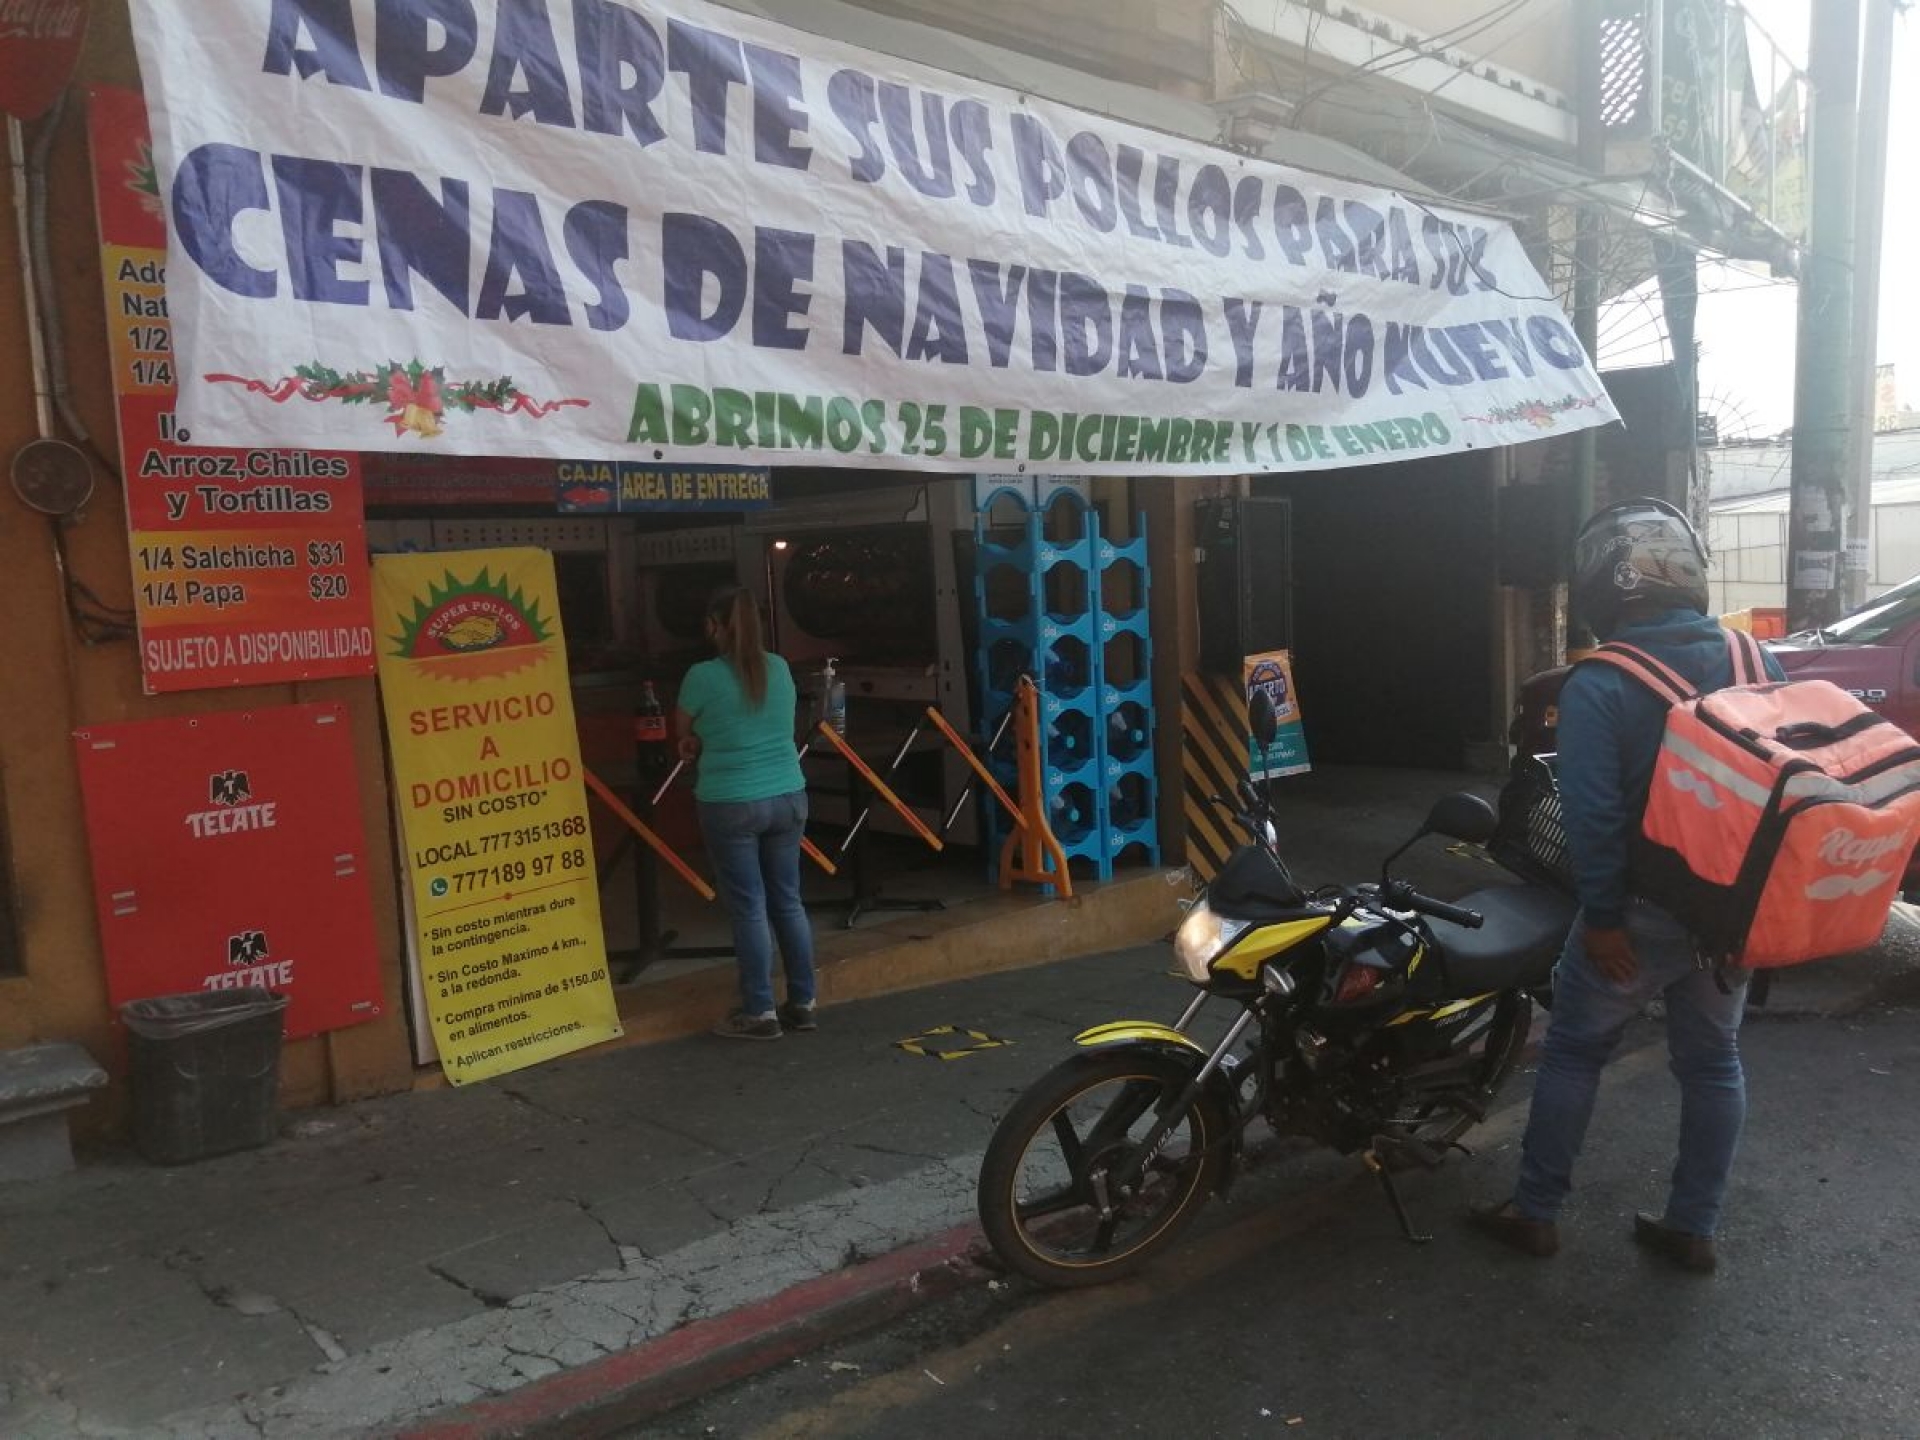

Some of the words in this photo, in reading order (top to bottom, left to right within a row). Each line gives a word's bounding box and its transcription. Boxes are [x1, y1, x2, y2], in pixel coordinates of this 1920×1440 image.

[262, 0, 813, 172] APARTE
[827, 68, 997, 207] SUS
[1010, 112, 1266, 261] POLLOS
[1274, 183, 1420, 286] PARA
[172, 141, 632, 333] CENAS
[662, 212, 816, 351] DE
[841, 239, 1208, 385] NAVIDAD
[1223, 297, 1262, 388] Y
[1276, 293, 1375, 399] AÑO
[1384, 314, 1586, 397] NUEVO
[129, 327, 168, 352] 1/2
[132, 360, 172, 385] 1/4
[627, 382, 886, 455] ABRIMOS
[898, 401, 948, 458] 25
[959, 405, 1019, 460] DE
[1028, 410, 1231, 465] DICIEMBRE
[1240, 421, 1265, 465] Y
[1285, 422, 1334, 461] DE
[1334, 411, 1452, 457] ENERO
[558, 463, 613, 482] CAJA
[622, 471, 667, 500] AREA
[671, 471, 693, 500] DE
[697, 471, 769, 500] ENTREGA
[167, 491, 188, 519] y
[198, 486, 331, 513] Tortillas
[139, 547, 174, 571] 1/4
[182, 543, 296, 570] Salchicha
[307, 541, 345, 566] $31
[143, 582, 178, 606] 1/4
[185, 581, 245, 609] Papa
[310, 574, 348, 601] $20
[427, 603, 469, 638] SUPER
[471, 601, 521, 631] POLLOS
[147, 635, 219, 673] SUJETO
[223, 638, 236, 667] A
[239, 626, 373, 665] DISPONIBILIDAD
[409, 692, 555, 735] SERVICIO
[479, 735, 500, 761] A
[411, 757, 572, 809] DOMICILIO
[184, 802, 277, 838] TECATE
[444, 803, 473, 823] SIN
[416, 840, 478, 869] LOCAL
[532, 854, 554, 876] 97
[561, 848, 585, 870] 88
[431, 926, 452, 941] Sin
[455, 917, 491, 935] costo
[493, 905, 547, 926] mientras
[550, 895, 576, 911] dure
[432, 944, 444, 956] la
[447, 922, 531, 953] contingencia.
[437, 969, 459, 984] Sin
[461, 958, 499, 977] Costo
[551, 940, 560, 952] 4
[440, 987, 449, 998] a
[450, 982, 463, 996] la
[466, 967, 521, 991] redonda.
[444, 1002, 495, 1026] Compra
[544, 983, 560, 996] de
[561, 968, 606, 992] $150.00
[449, 1029, 465, 1042] en
[468, 1009, 531, 1037] alimentos.
[456, 1045, 503, 1068] Aplican
[505, 1020, 586, 1051] restricciones.
